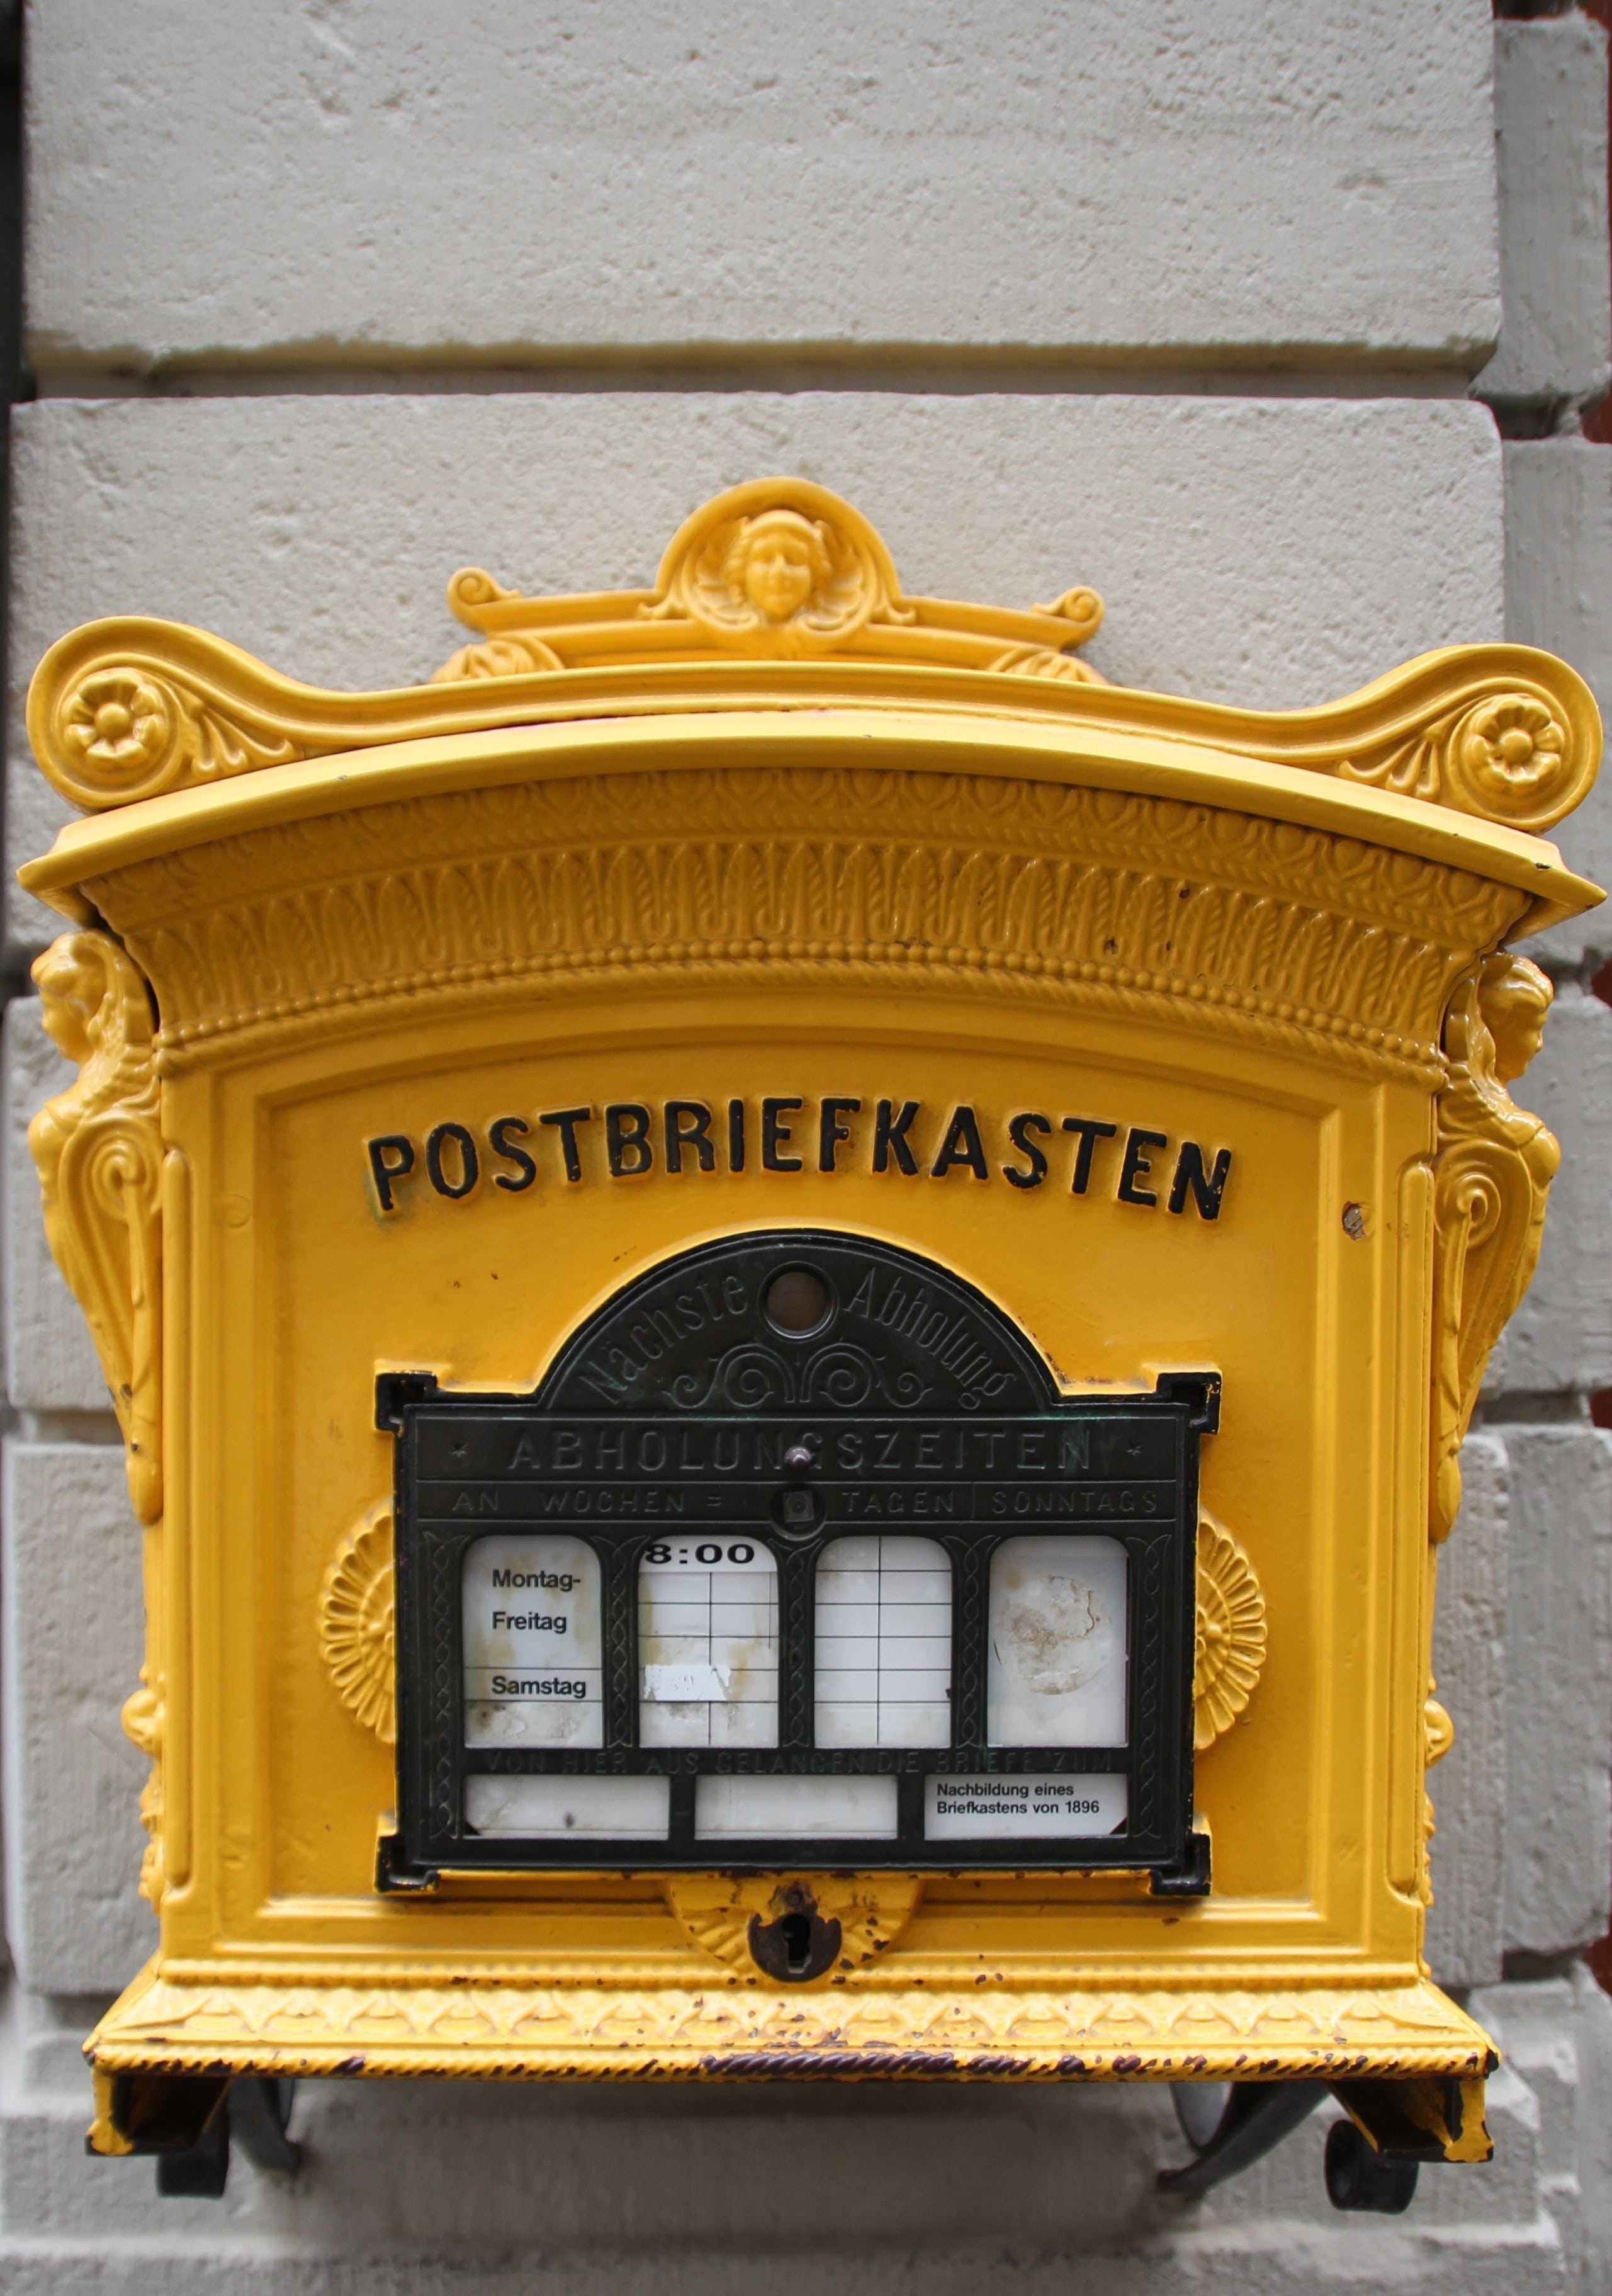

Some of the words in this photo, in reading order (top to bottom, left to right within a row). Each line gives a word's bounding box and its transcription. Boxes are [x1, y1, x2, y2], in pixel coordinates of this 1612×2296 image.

[368, 1097, 1232, 1221] POSTBRIEFKASTEN
[578, 1275, 748, 1406] Nächste
[843, 1267, 1017, 1410] Abholung
[507, 1430, 1090, 1471] ABHOLUNGSZEITEN
[452, 1490, 500, 1512] AN
[543, 1490, 685, 1513] WOCHEN
[840, 1490, 954, 1512] TAGEN
[991, 1490, 1157, 1513] SONNTAGS
[645, 1543, 755, 1564] 8:00
[492, 1569, 581, 1592] Montag-
[492, 1610, 567, 1634] Freitag
[491, 1675, 587, 1699] Samstag
[562, 1751, 627, 1773] HIER
[645, 1751, 699, 1773] AUS
[877, 1751, 920, 1773] DIE
[936, 1751, 1037, 1773] BRIEFE
[937, 1783, 1029, 1799] Nachbildung
[1034, 1783, 1074, 1796] eines
[937, 1801, 1028, 1814] Briefkastens
[1032, 1804, 1059, 1814] von
[1065, 1801, 1100, 1814] 1896
